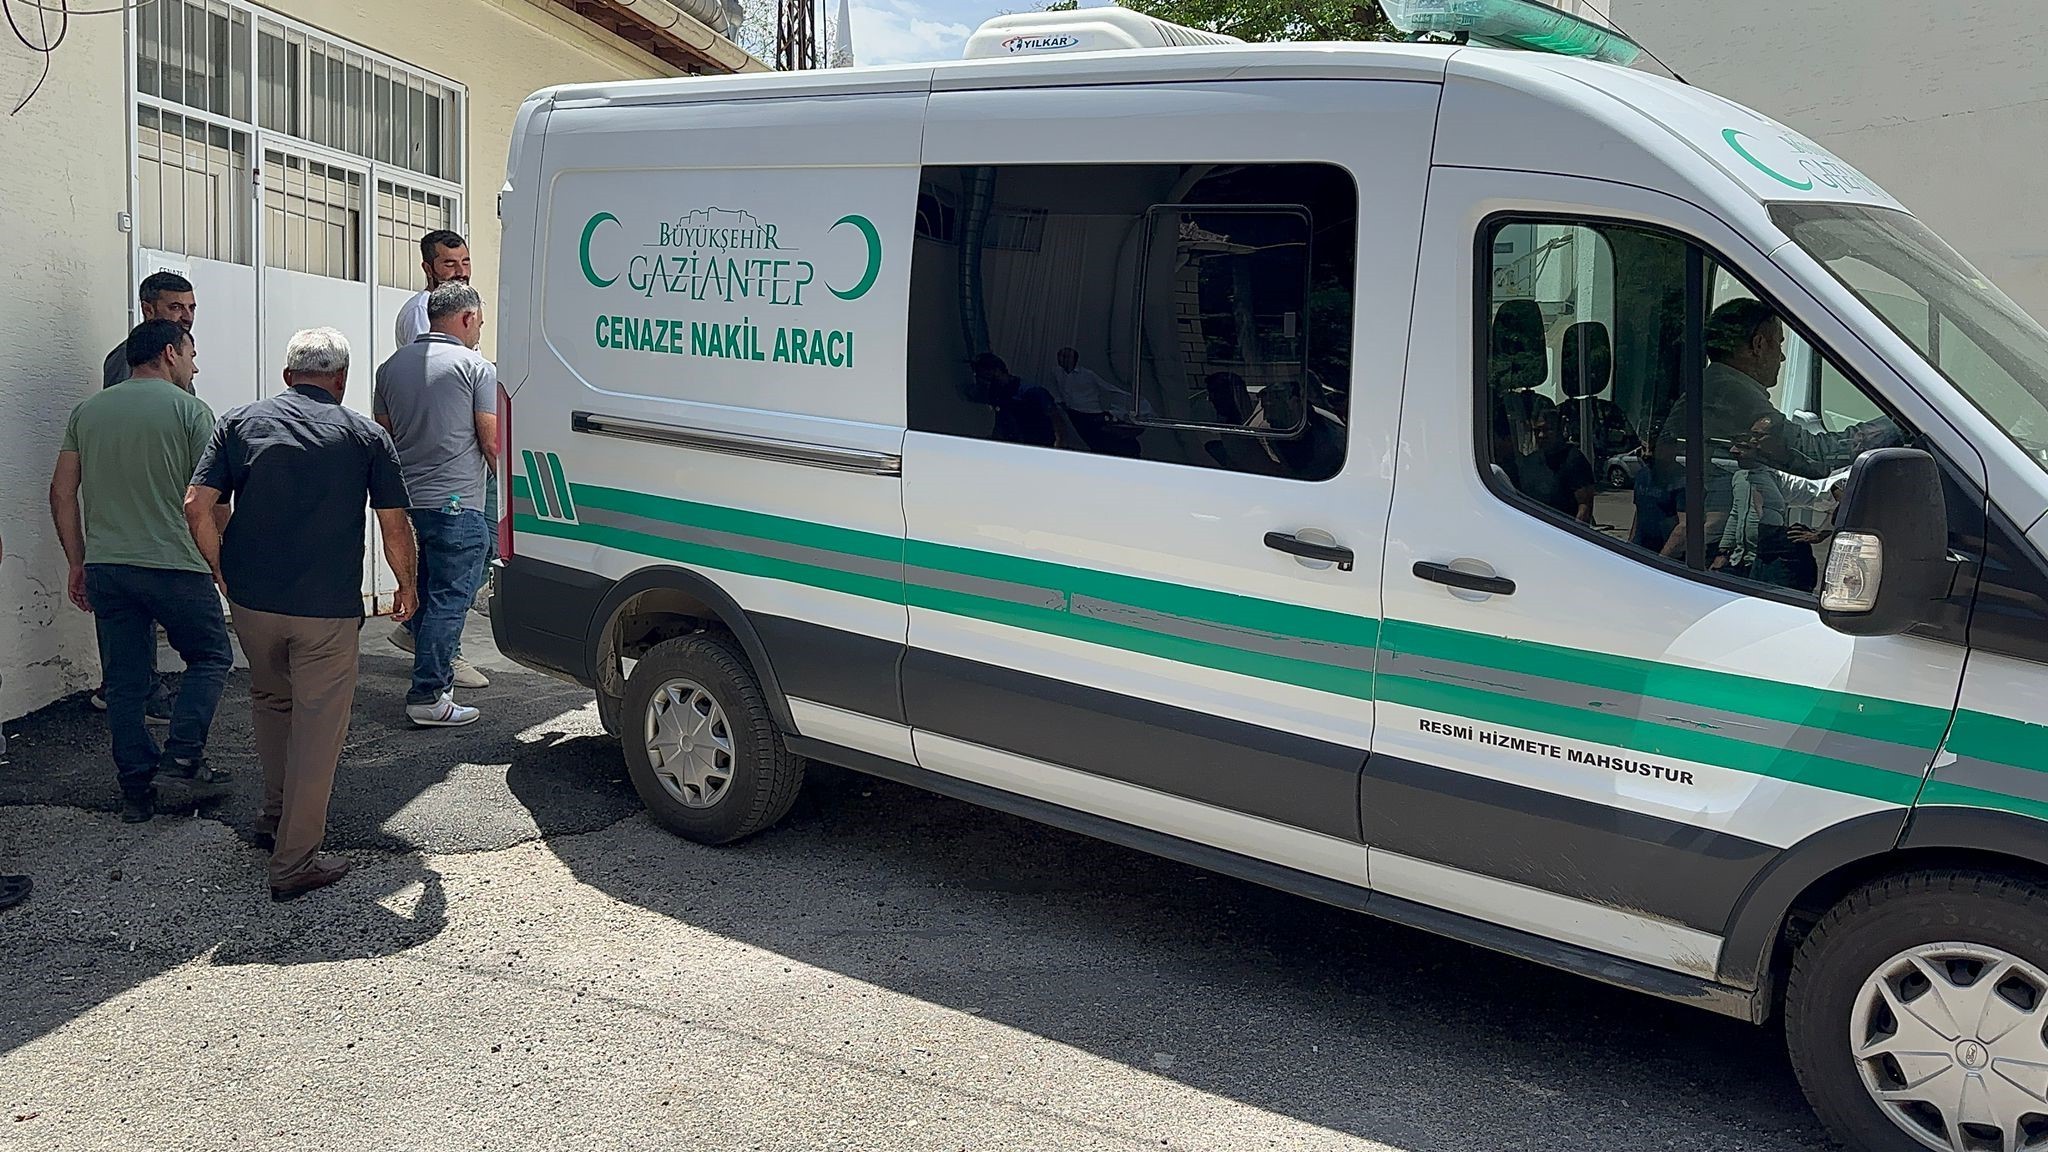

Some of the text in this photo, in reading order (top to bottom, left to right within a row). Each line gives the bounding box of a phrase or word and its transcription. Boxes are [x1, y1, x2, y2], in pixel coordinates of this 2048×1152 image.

[1024, 38, 1068, 48] YILKAR
[659, 221, 779, 253] BÜYÜKŞEHİR
[628, 250, 814, 306] GAZİANTEP
[595, 315, 853, 368] CENAZE NAKİL ARACI
[1419, 718, 1694, 785] RESMİ HİZMETE MAHSUSTUR
